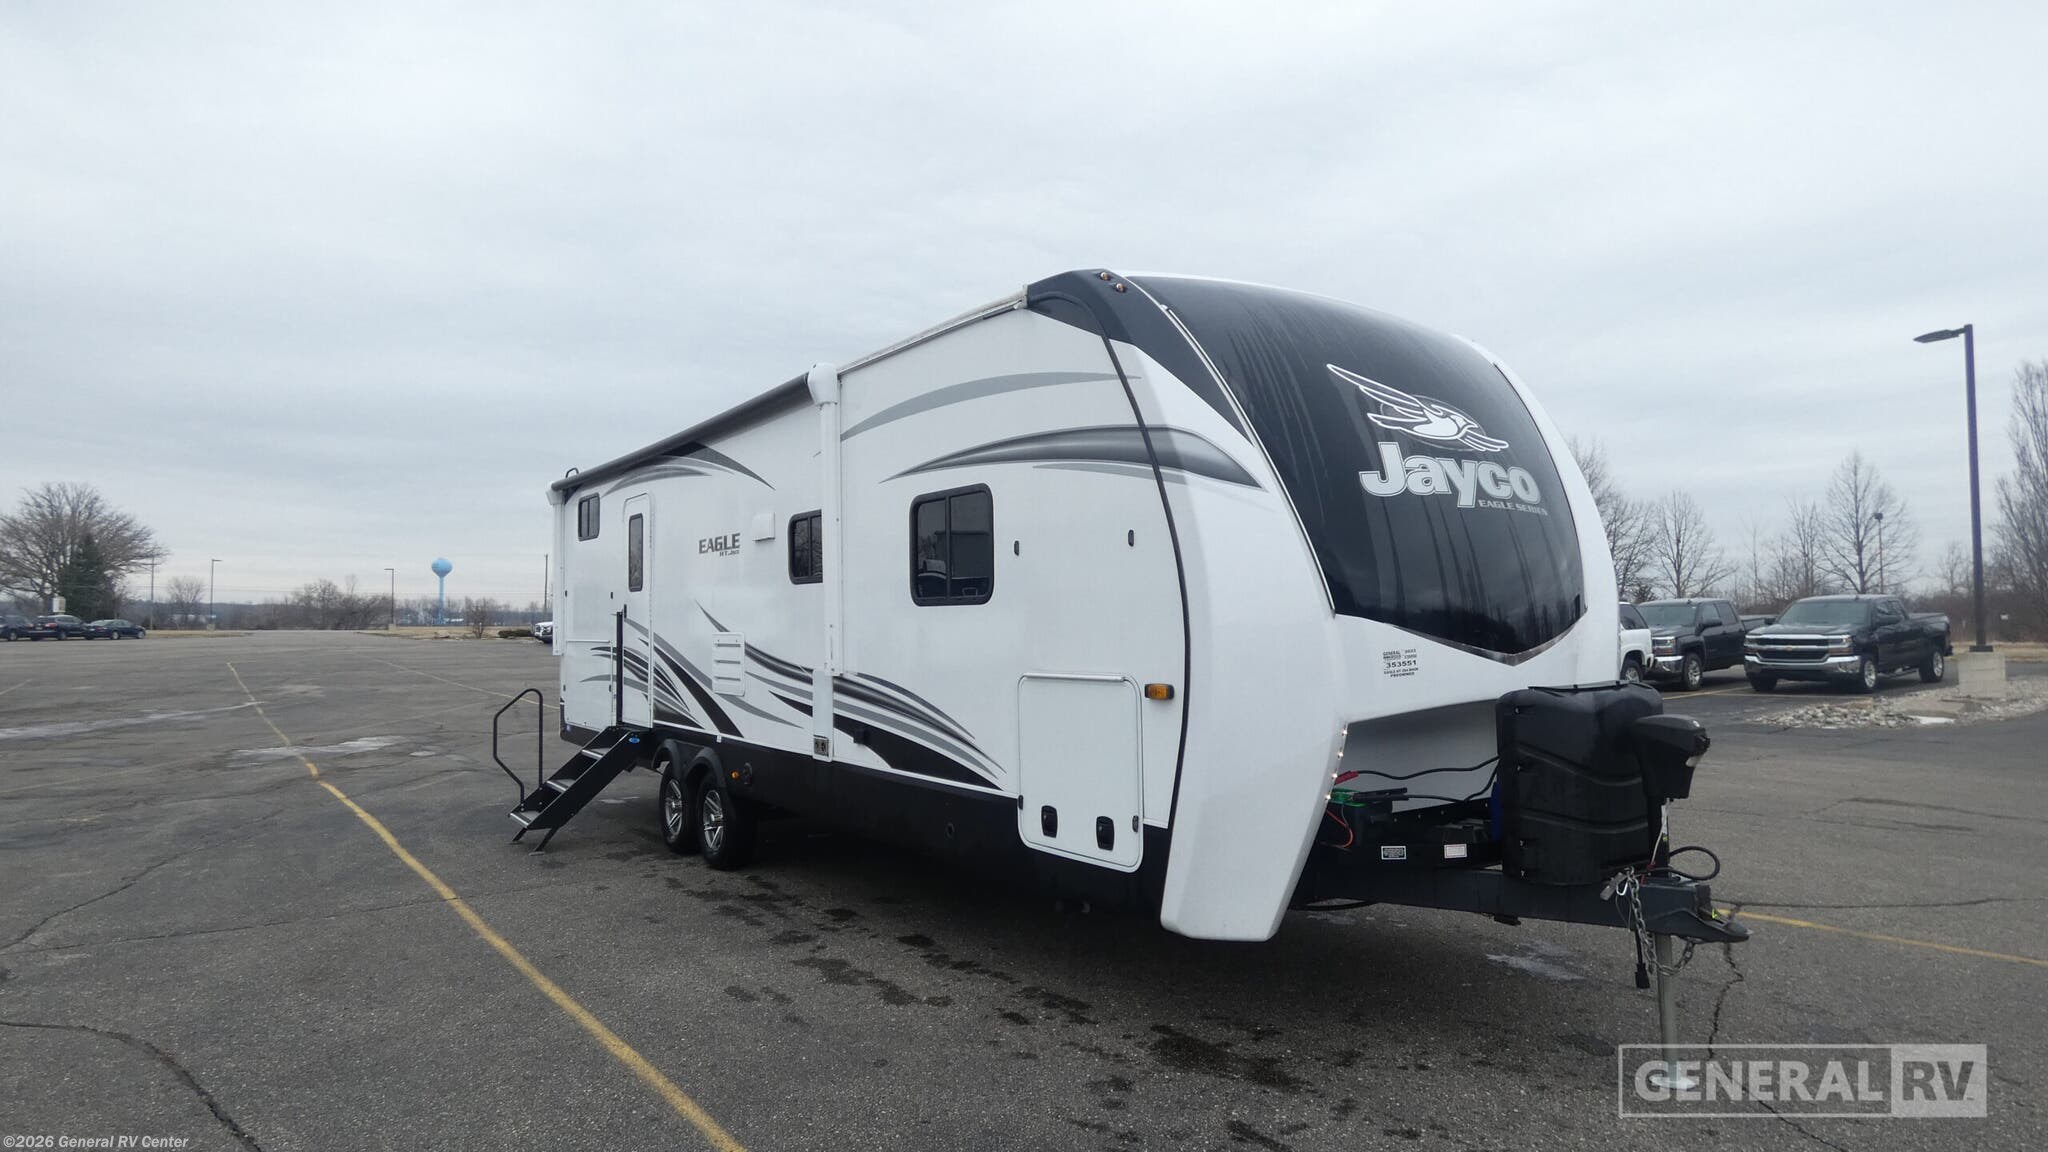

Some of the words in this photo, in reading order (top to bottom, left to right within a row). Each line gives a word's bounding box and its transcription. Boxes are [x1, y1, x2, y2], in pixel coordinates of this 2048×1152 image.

[1358, 441, 1541, 508] Jayco
[1478, 499, 1515, 511] EAGLE
[699, 533, 740, 554] EAGLE
[1386, 660, 1416, 668] 353551
